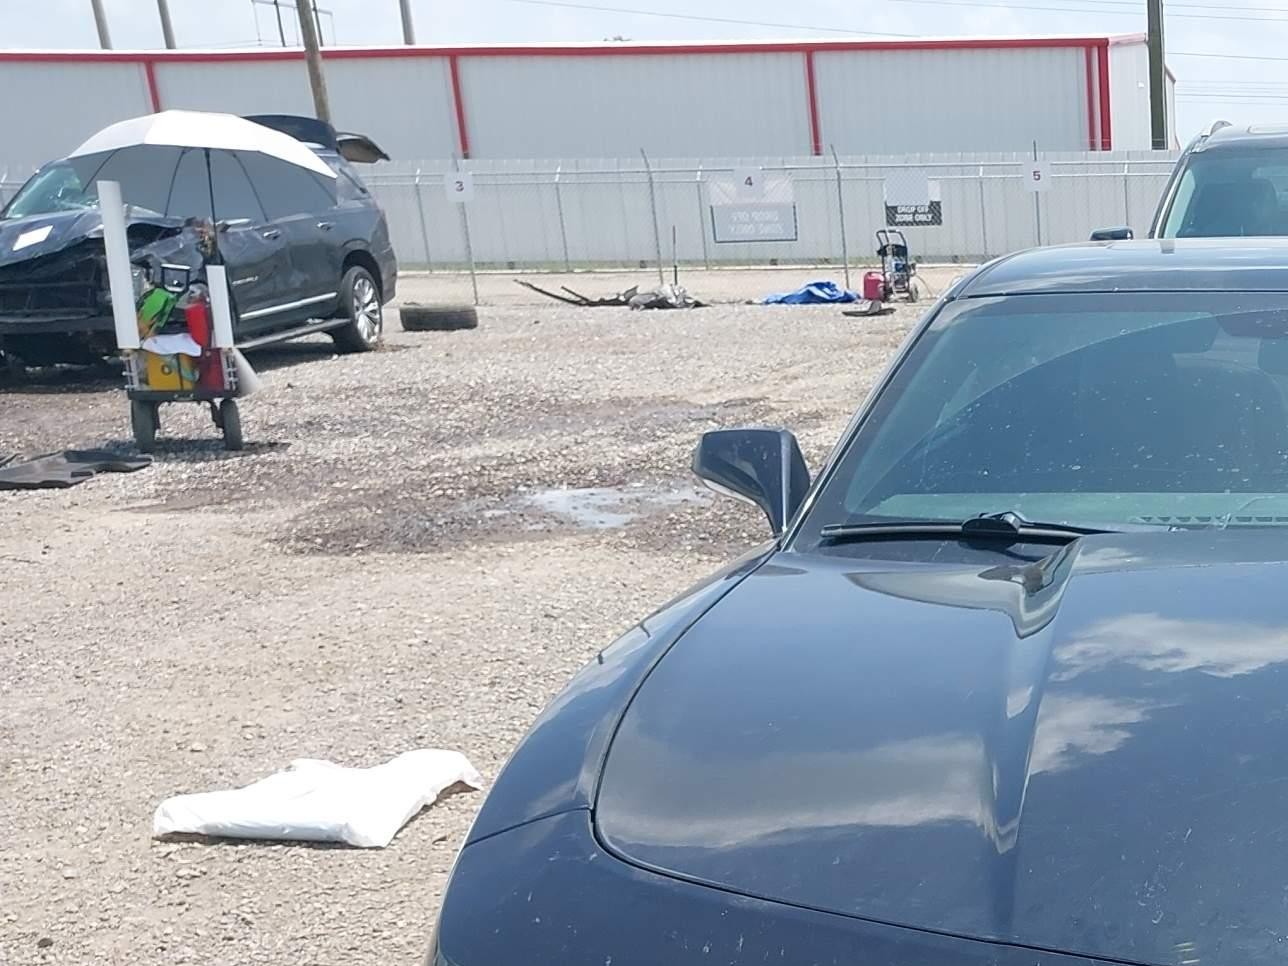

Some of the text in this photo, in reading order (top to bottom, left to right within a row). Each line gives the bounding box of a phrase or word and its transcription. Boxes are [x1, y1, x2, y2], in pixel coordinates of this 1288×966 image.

[1032, 170, 1041, 181] 5
[455, 180, 465, 192] 3
[744, 176, 753, 187] 4
